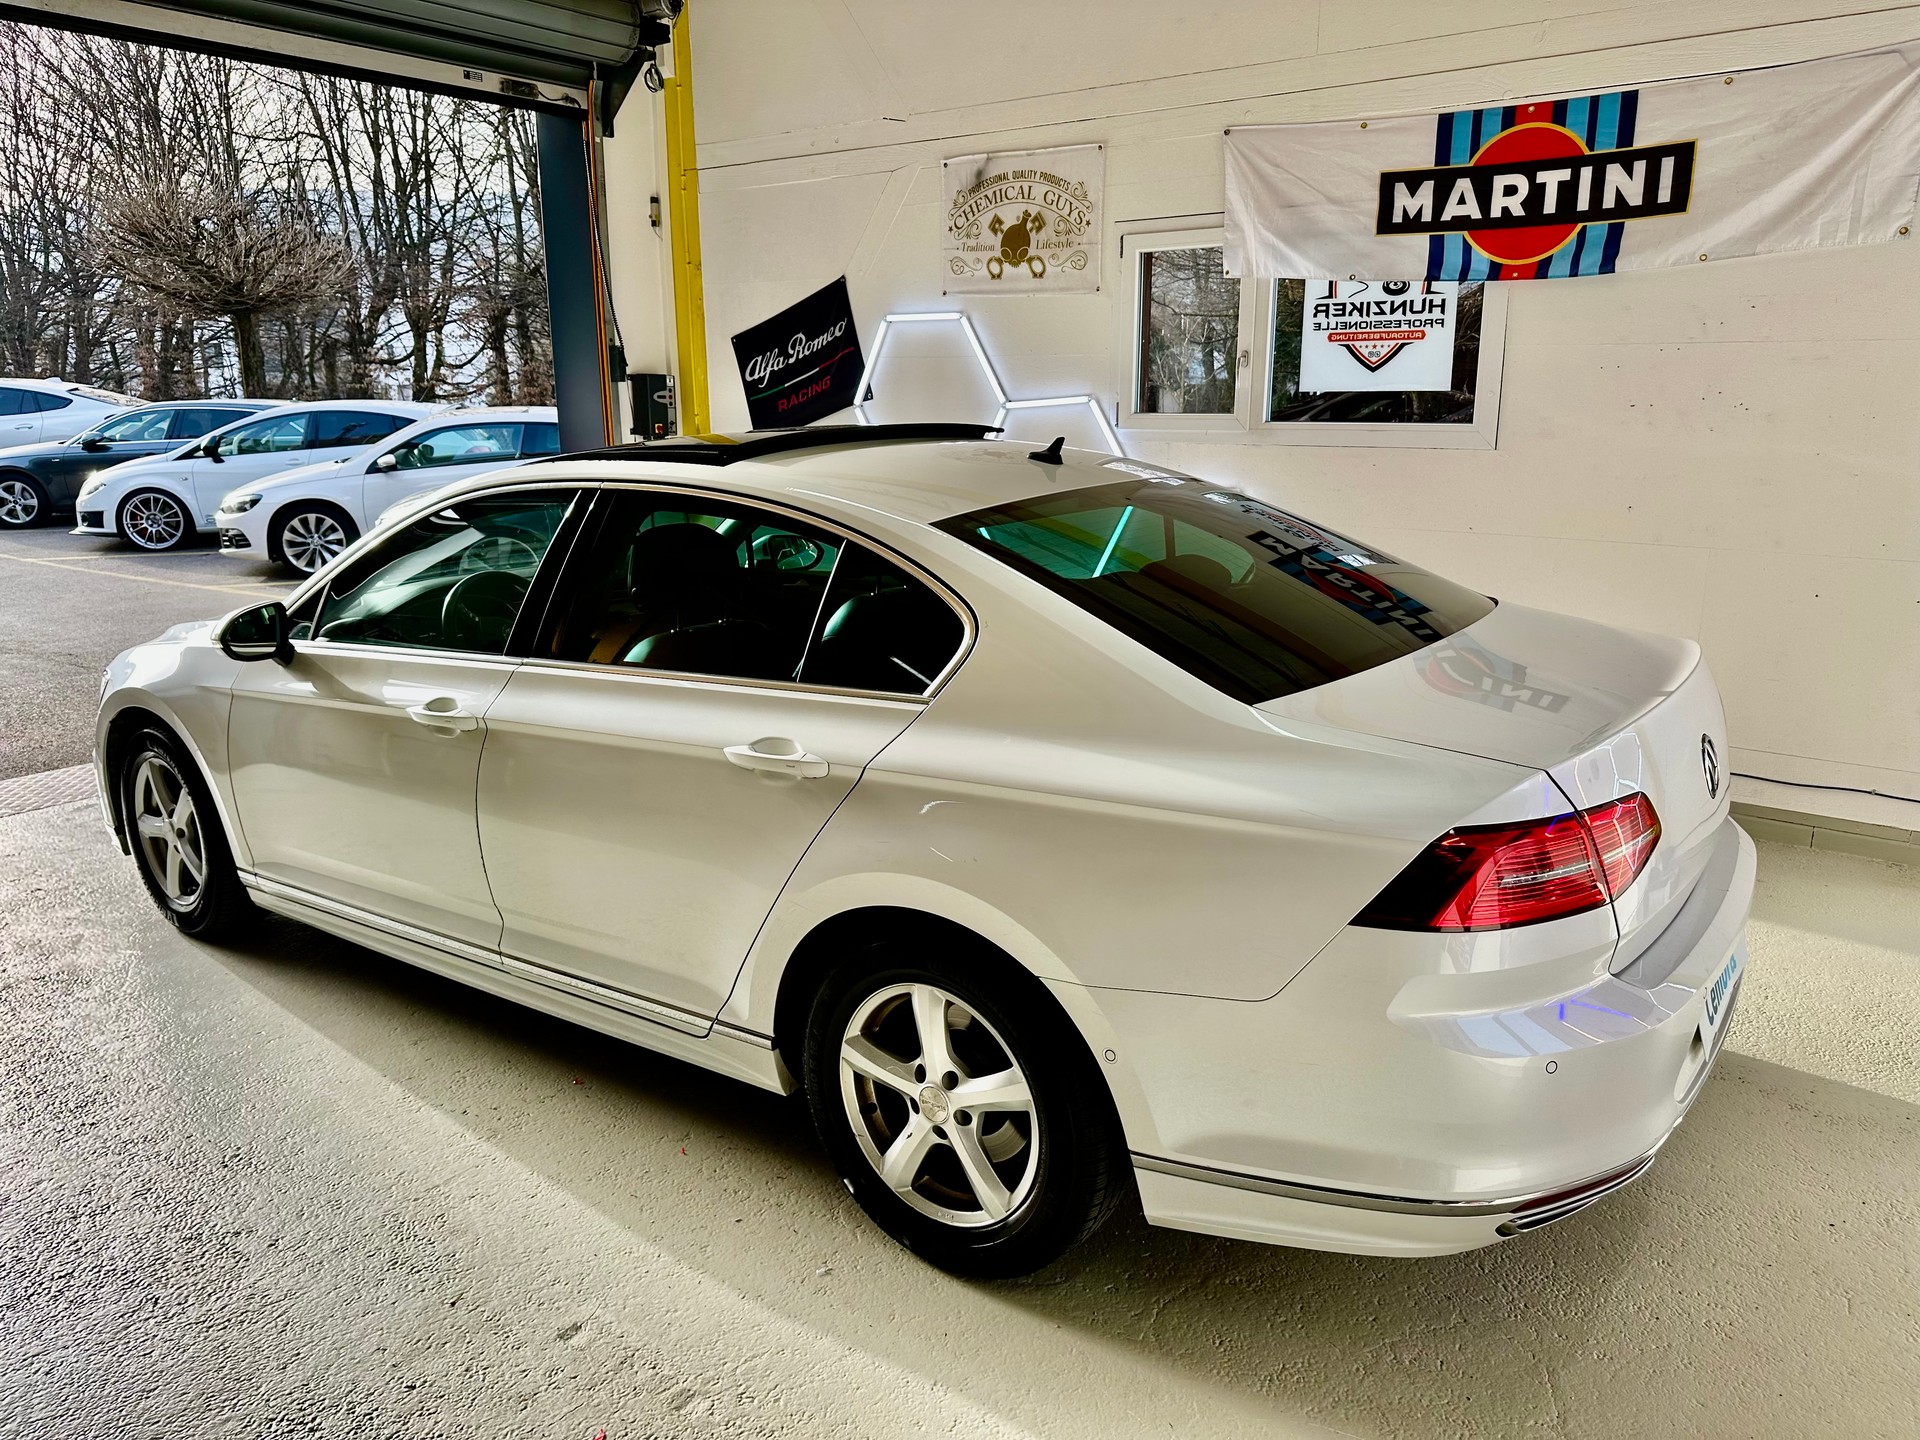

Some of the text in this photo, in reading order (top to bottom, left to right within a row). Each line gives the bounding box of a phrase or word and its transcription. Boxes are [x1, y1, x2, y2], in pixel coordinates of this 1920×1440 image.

[967, 170, 1071, 197] PROFESSIONAL QUALITY PRODUCTS
[1391, 156, 1675, 224] MARTINI
[953, 185, 1086, 230] CHEMICAL GUYS
[961, 238, 1075, 252] Tradition Lifestyle
[745, 317, 848, 388] Alfa Romeo
[777, 375, 831, 412] RACING
